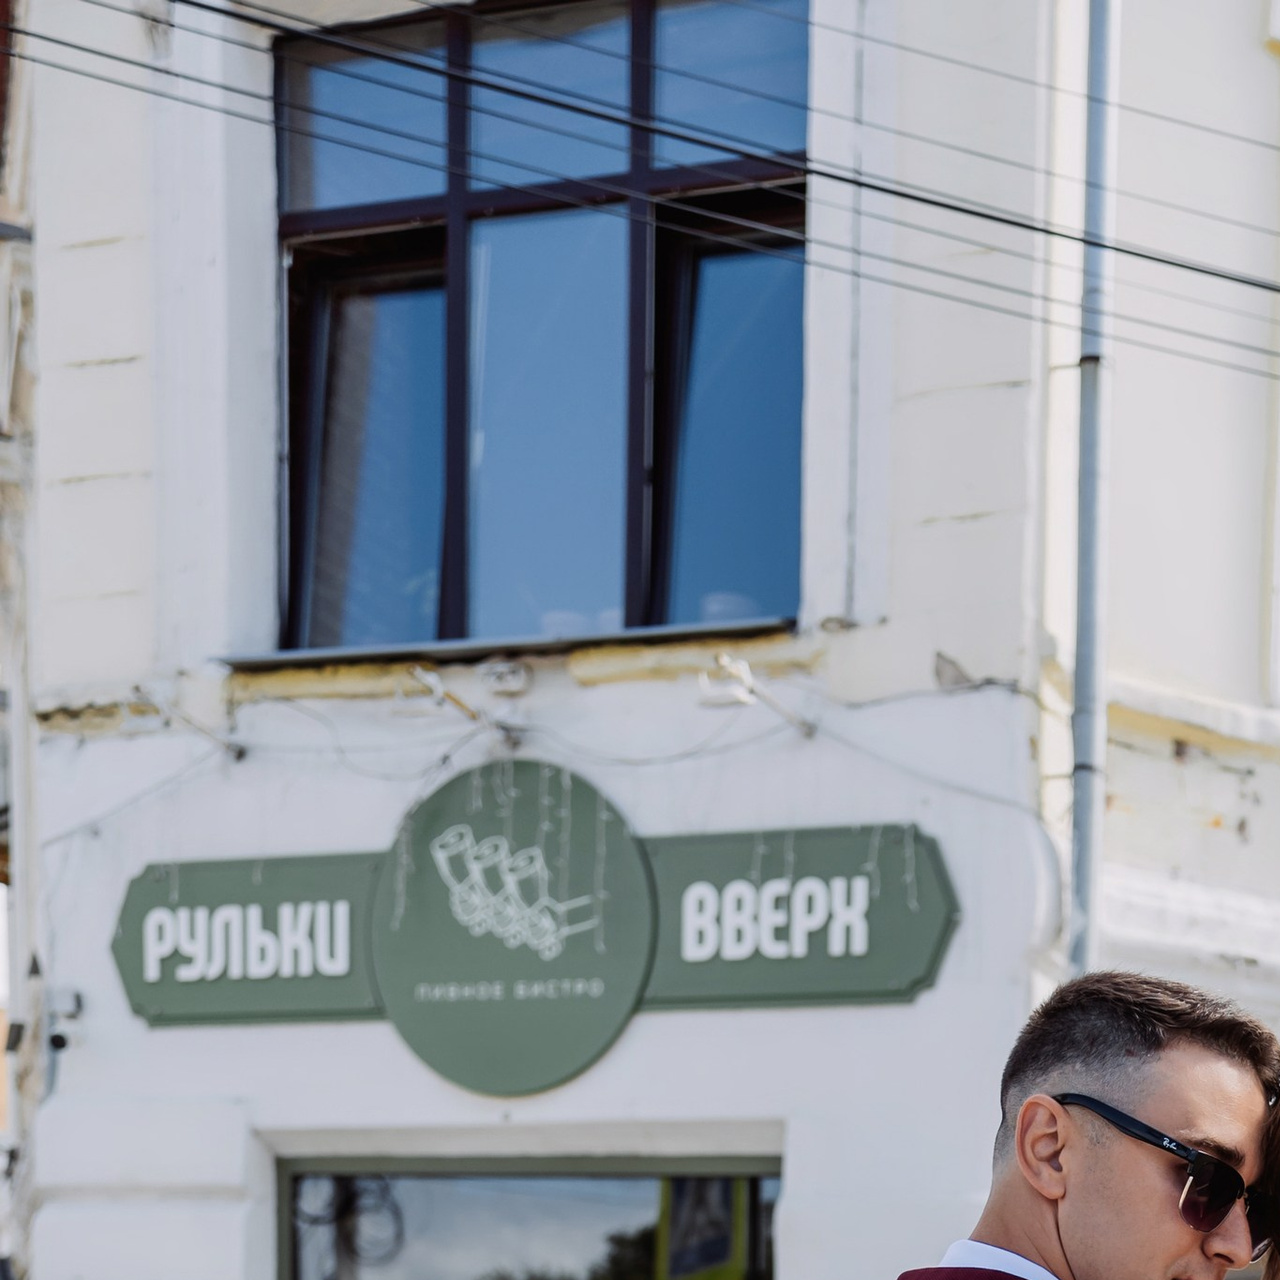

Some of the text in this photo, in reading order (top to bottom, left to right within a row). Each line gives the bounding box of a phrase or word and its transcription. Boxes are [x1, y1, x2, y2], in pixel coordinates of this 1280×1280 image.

[143, 876, 868, 982] РУЛЬКИ ВВЕРХ
[414, 977, 605, 1002] ПИВНОЕ БИСТРО
